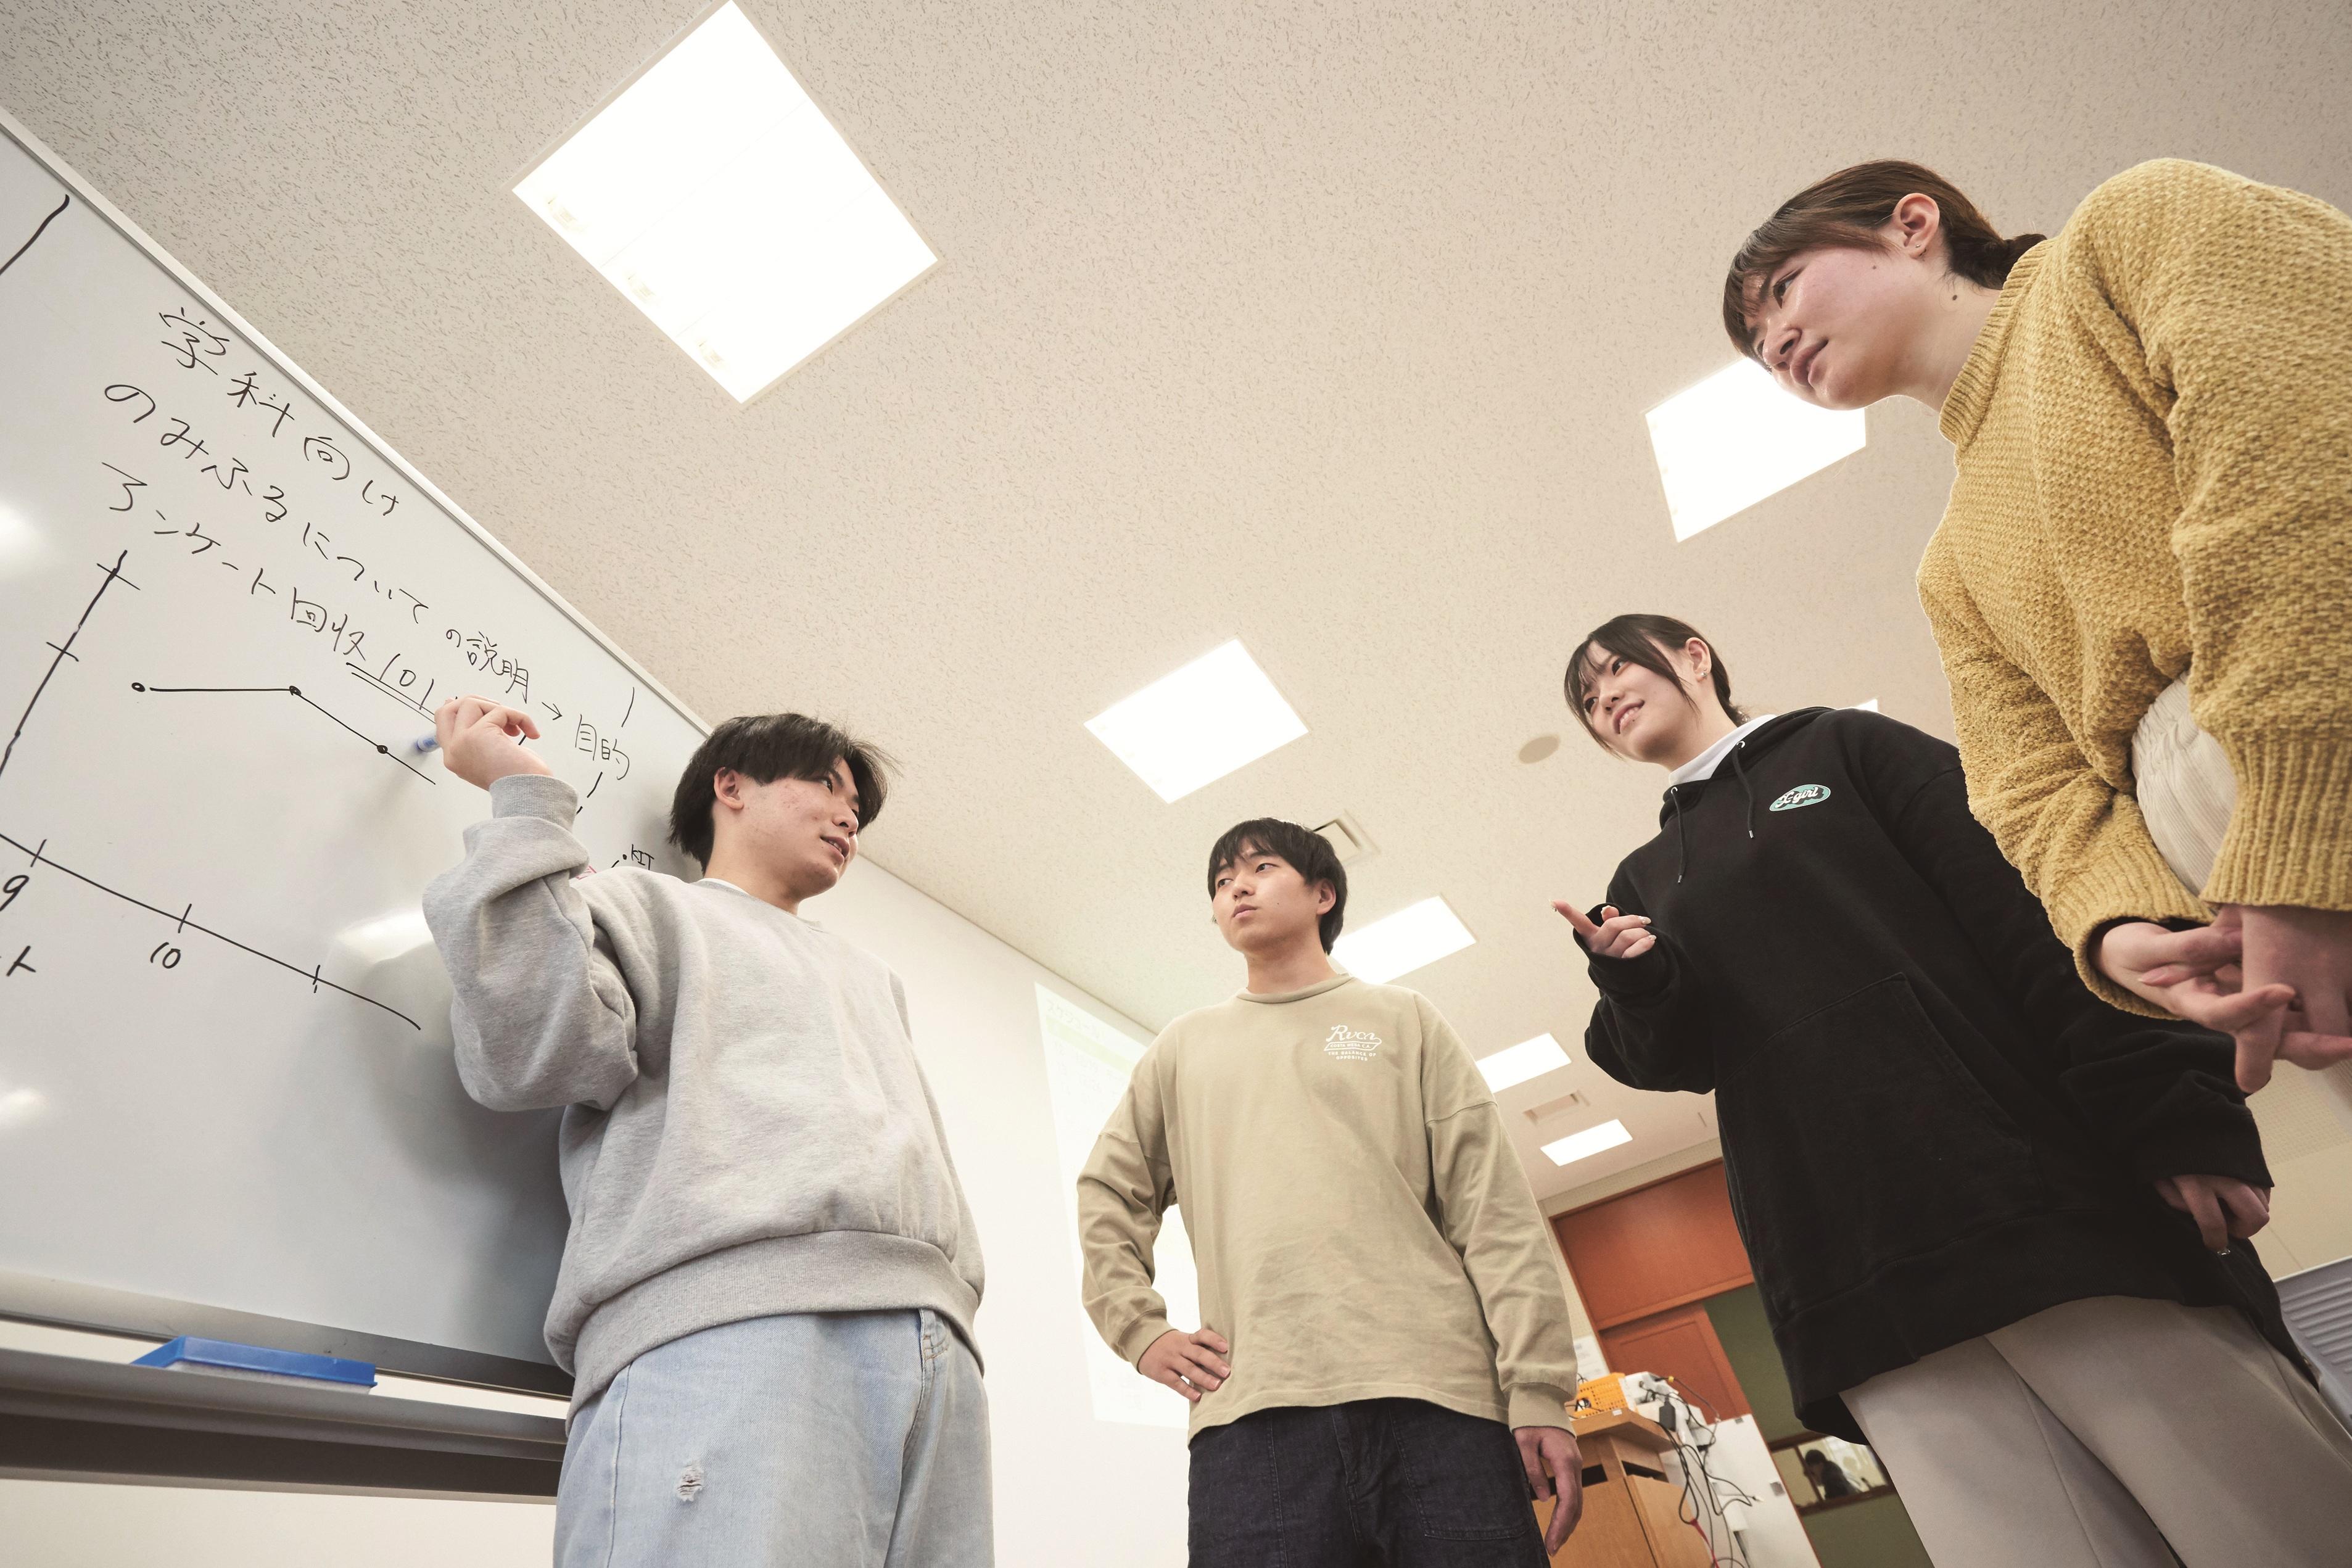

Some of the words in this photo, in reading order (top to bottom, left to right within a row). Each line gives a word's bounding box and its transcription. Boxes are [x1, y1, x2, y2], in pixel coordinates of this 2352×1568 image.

[159, 307, 399, 516] 学科向け
[574, 714, 630, 780] 目的
[1775, 786, 1822, 809] X-girl
[150, 941, 181, 969] 10
